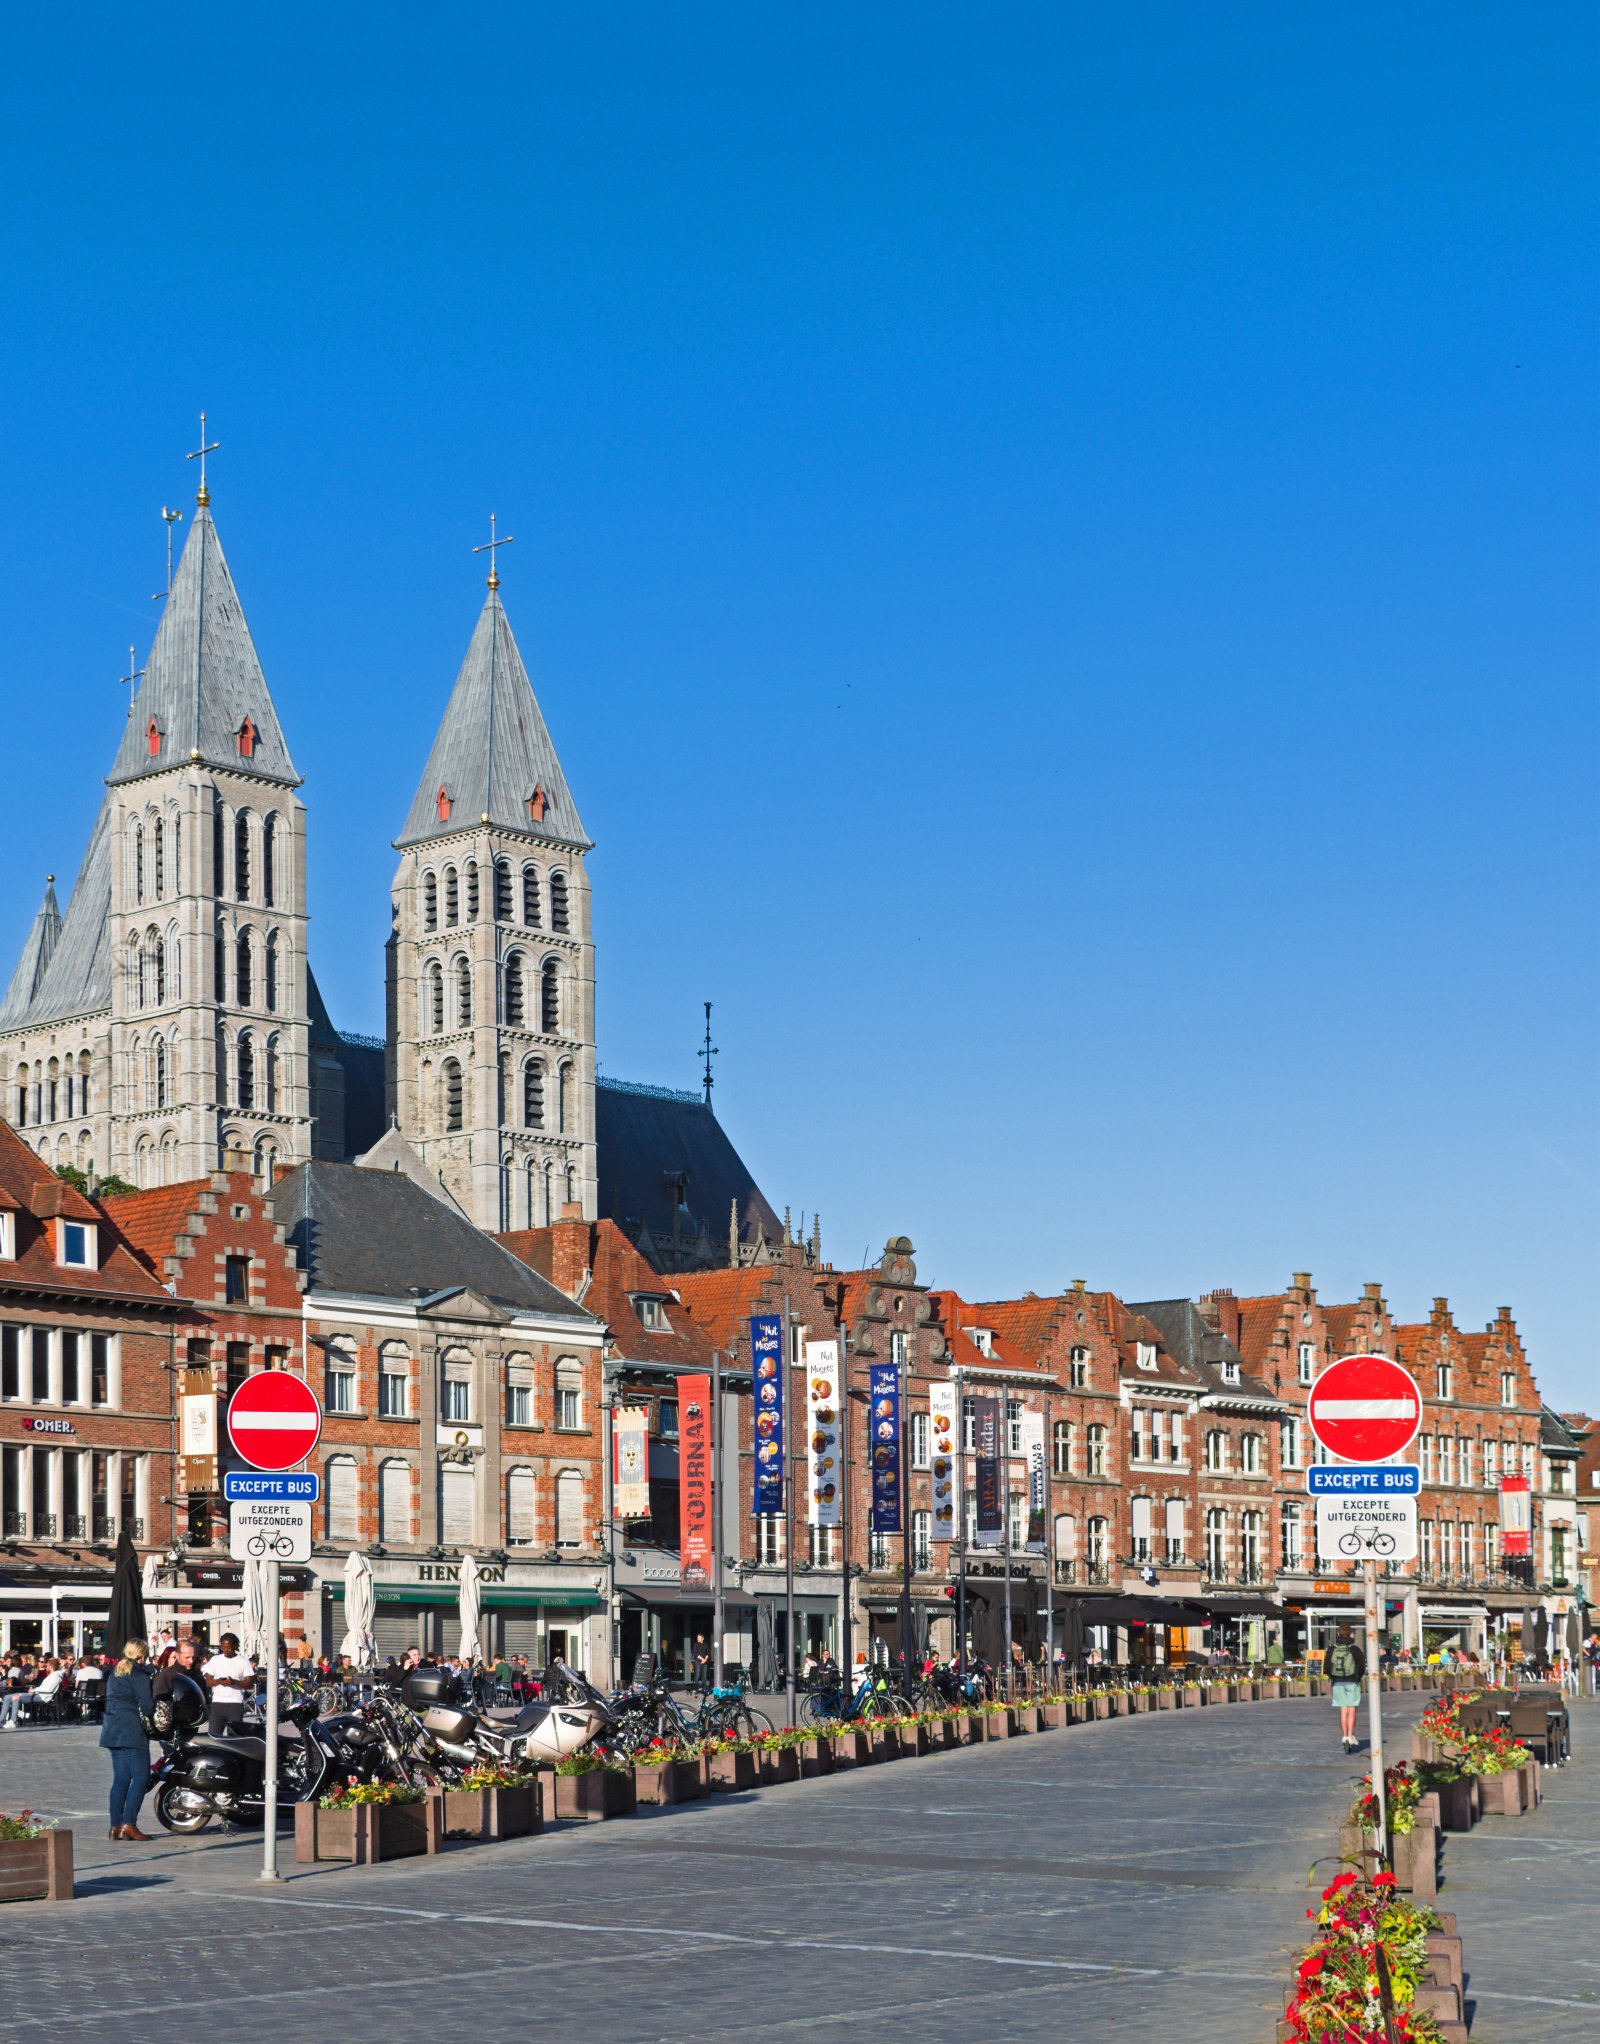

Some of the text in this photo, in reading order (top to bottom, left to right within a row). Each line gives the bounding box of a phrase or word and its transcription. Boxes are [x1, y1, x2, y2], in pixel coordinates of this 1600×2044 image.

[765, 1324, 779, 1336] Nuit
[755, 1340, 779, 1351] Musées
[820, 1351, 834, 1361] Nuit
[882, 1372, 896, 1382] Nuit
[873, 1385, 896, 1395] Musées
[941, 1391, 953, 1400] Nuit
[1031, 1443, 1039, 1504] RAFFAELLA
[1314, 1473, 1414, 1487] EXCEPTE BUS
[230, 1480, 312, 1493] EXCEPTE BUS
[251, 1505, 290, 1515] EXCEPTE
[1343, 1501, 1390, 1510] EXCEPTE
[238, 1516, 303, 1526] UITGEZONDERD
[1327, 1513, 1406, 1522] UITGEZONDERD
[418, 1564, 507, 1583] HENON
[375, 1593, 570, 1605] ENRION HENRION
